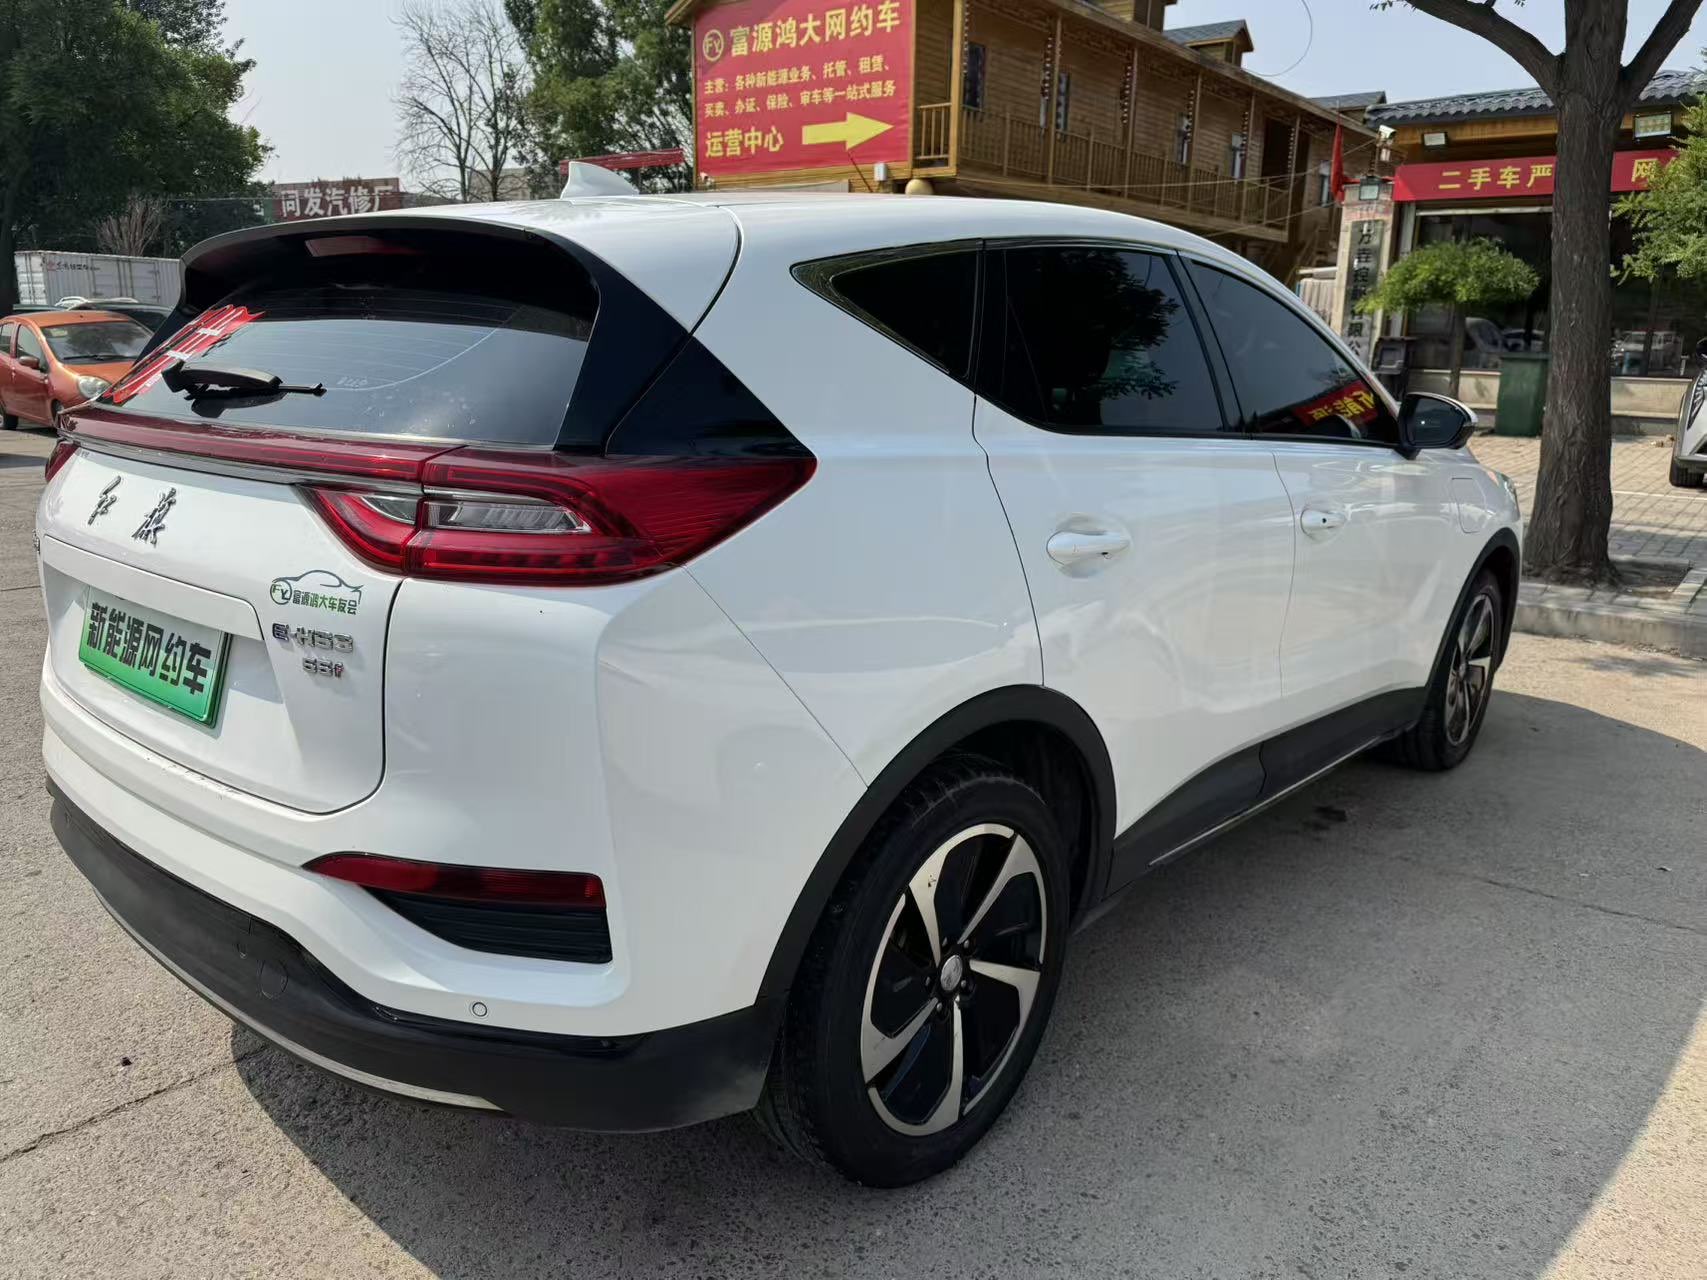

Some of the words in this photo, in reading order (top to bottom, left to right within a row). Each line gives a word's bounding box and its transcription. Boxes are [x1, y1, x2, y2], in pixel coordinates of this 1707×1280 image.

[730, 1, 900, 57] 富源鸿大网约车
[705, 126, 784, 158] 运营中心
[1438, 164, 1553, 190] 二手车严
[86, 601, 211, 695] 新能源网约车
